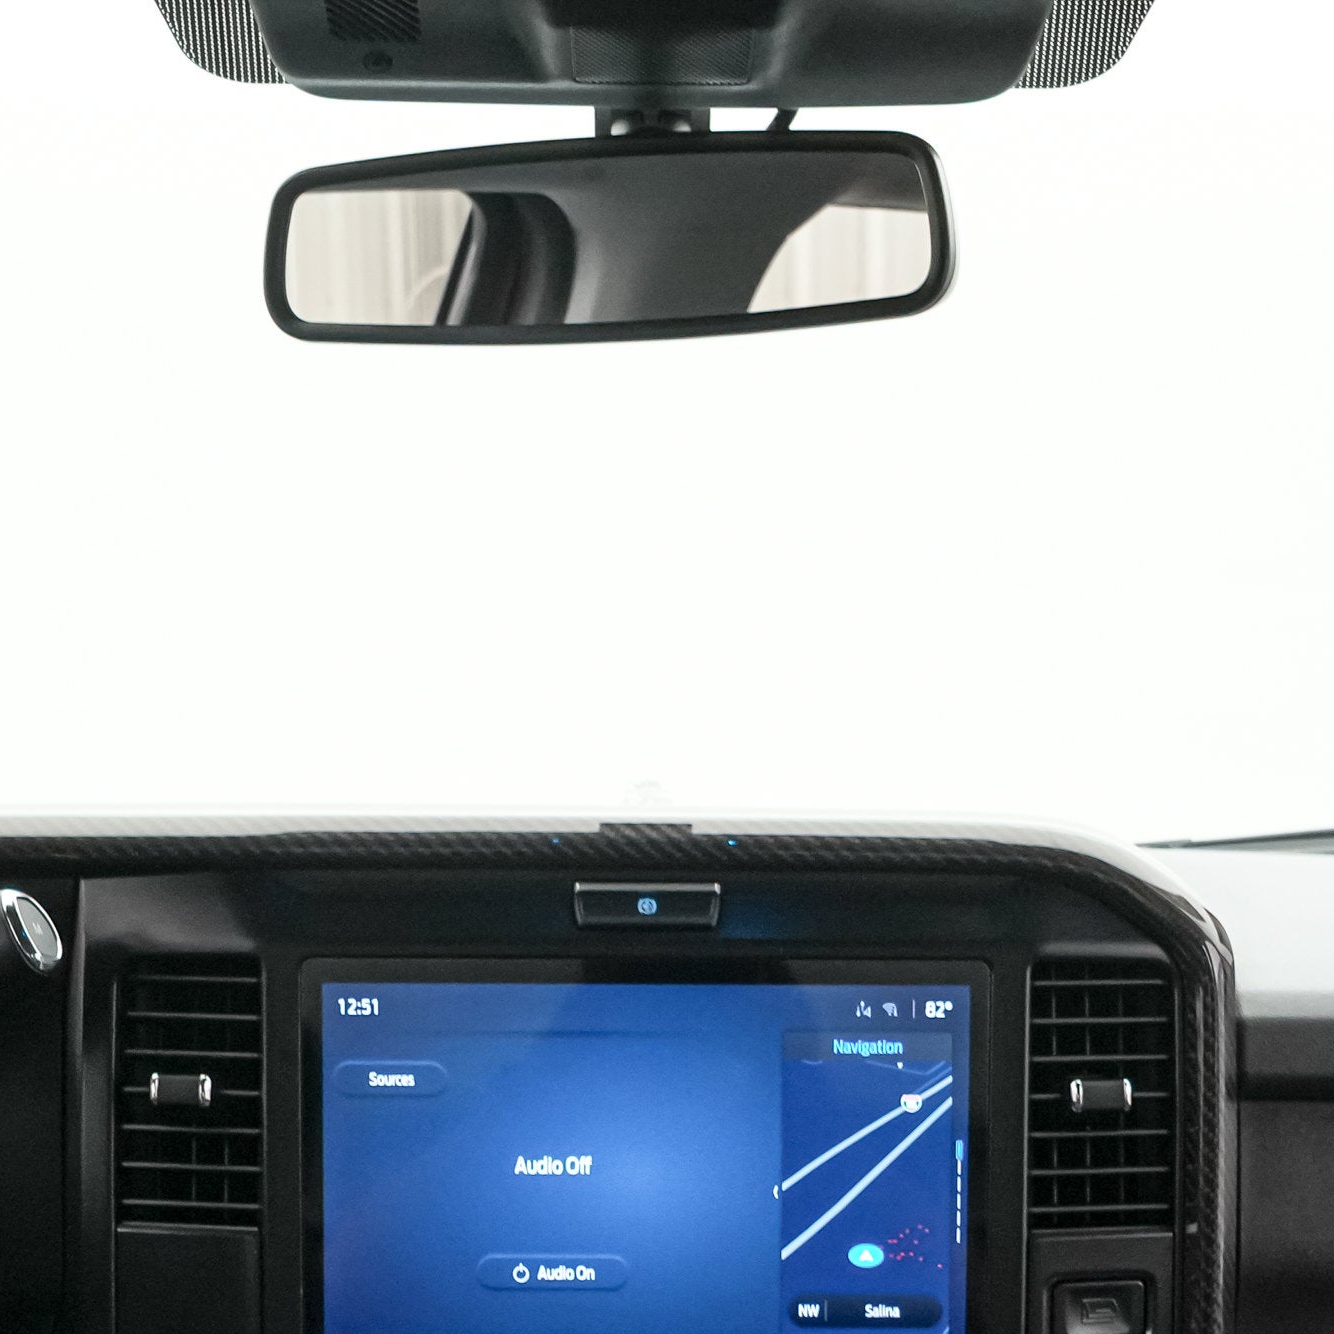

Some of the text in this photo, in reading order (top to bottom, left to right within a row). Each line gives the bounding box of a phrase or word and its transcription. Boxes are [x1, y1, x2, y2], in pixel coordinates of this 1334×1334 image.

[338, 997, 379, 1017] 12:51
[832, 1039, 904, 1057] Navigation
[368, 1072, 415, 1088] Sources
[514, 1155, 593, 1175] Audio Off
[537, 1265, 596, 1281] Audio On
[798, 1304, 820, 1318] NW
[864, 1303, 901, 1319] Salina
